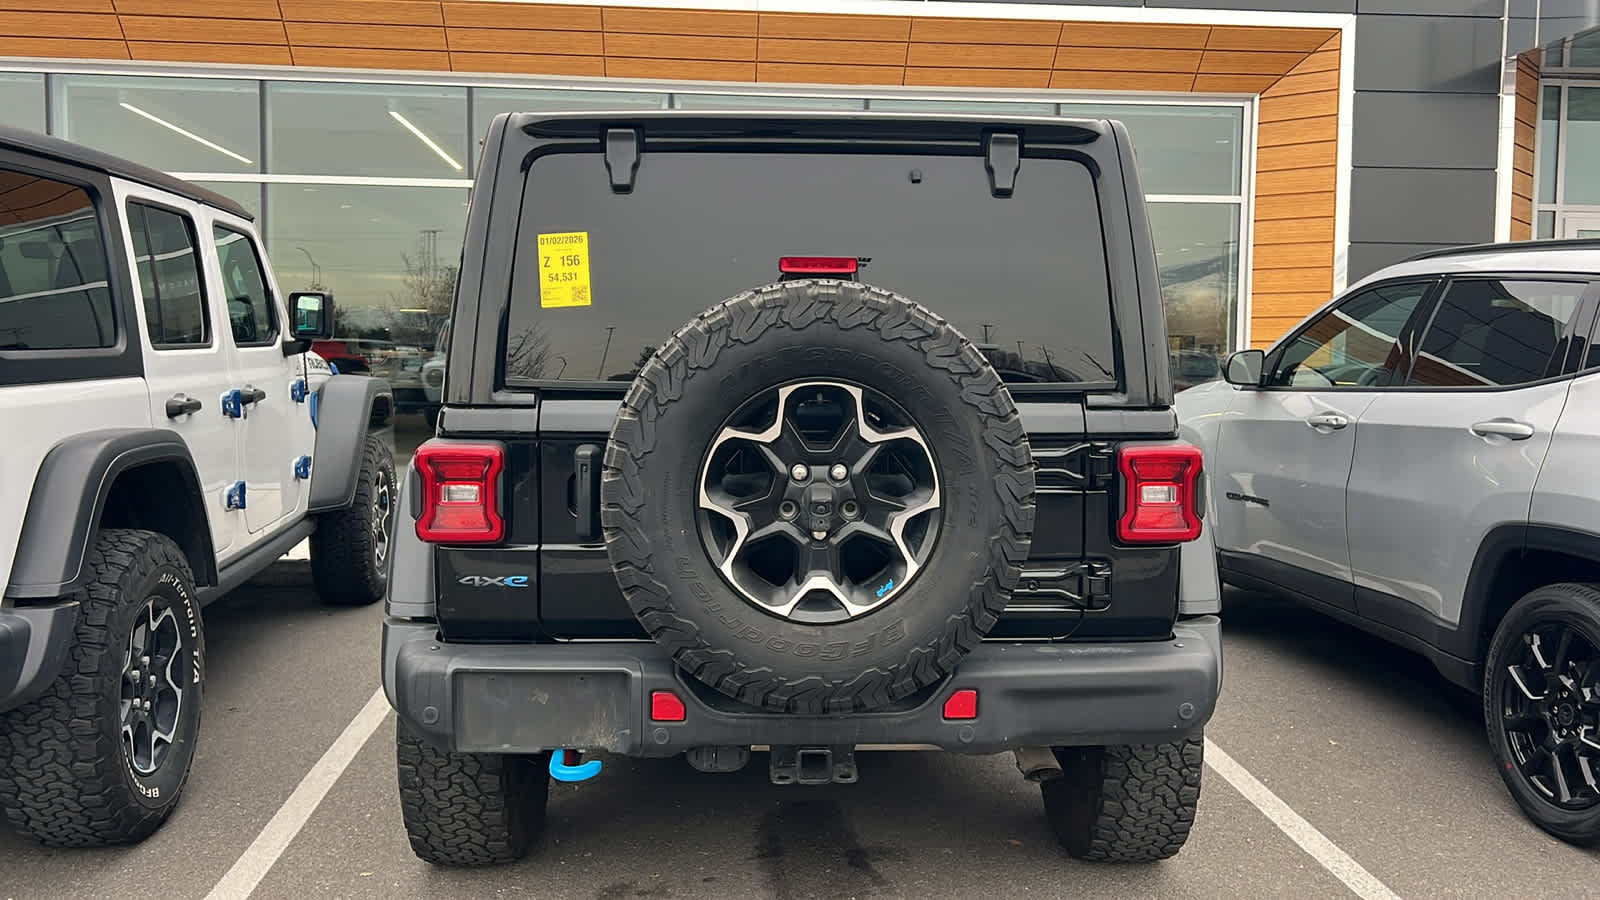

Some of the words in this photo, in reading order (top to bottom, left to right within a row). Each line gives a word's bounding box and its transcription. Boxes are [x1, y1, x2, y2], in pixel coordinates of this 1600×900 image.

[540, 235, 584, 246] 01/02/2026
[543, 256, 551, 268] Z
[560, 254, 581, 267] 156
[548, 272, 578, 283] 54,531
